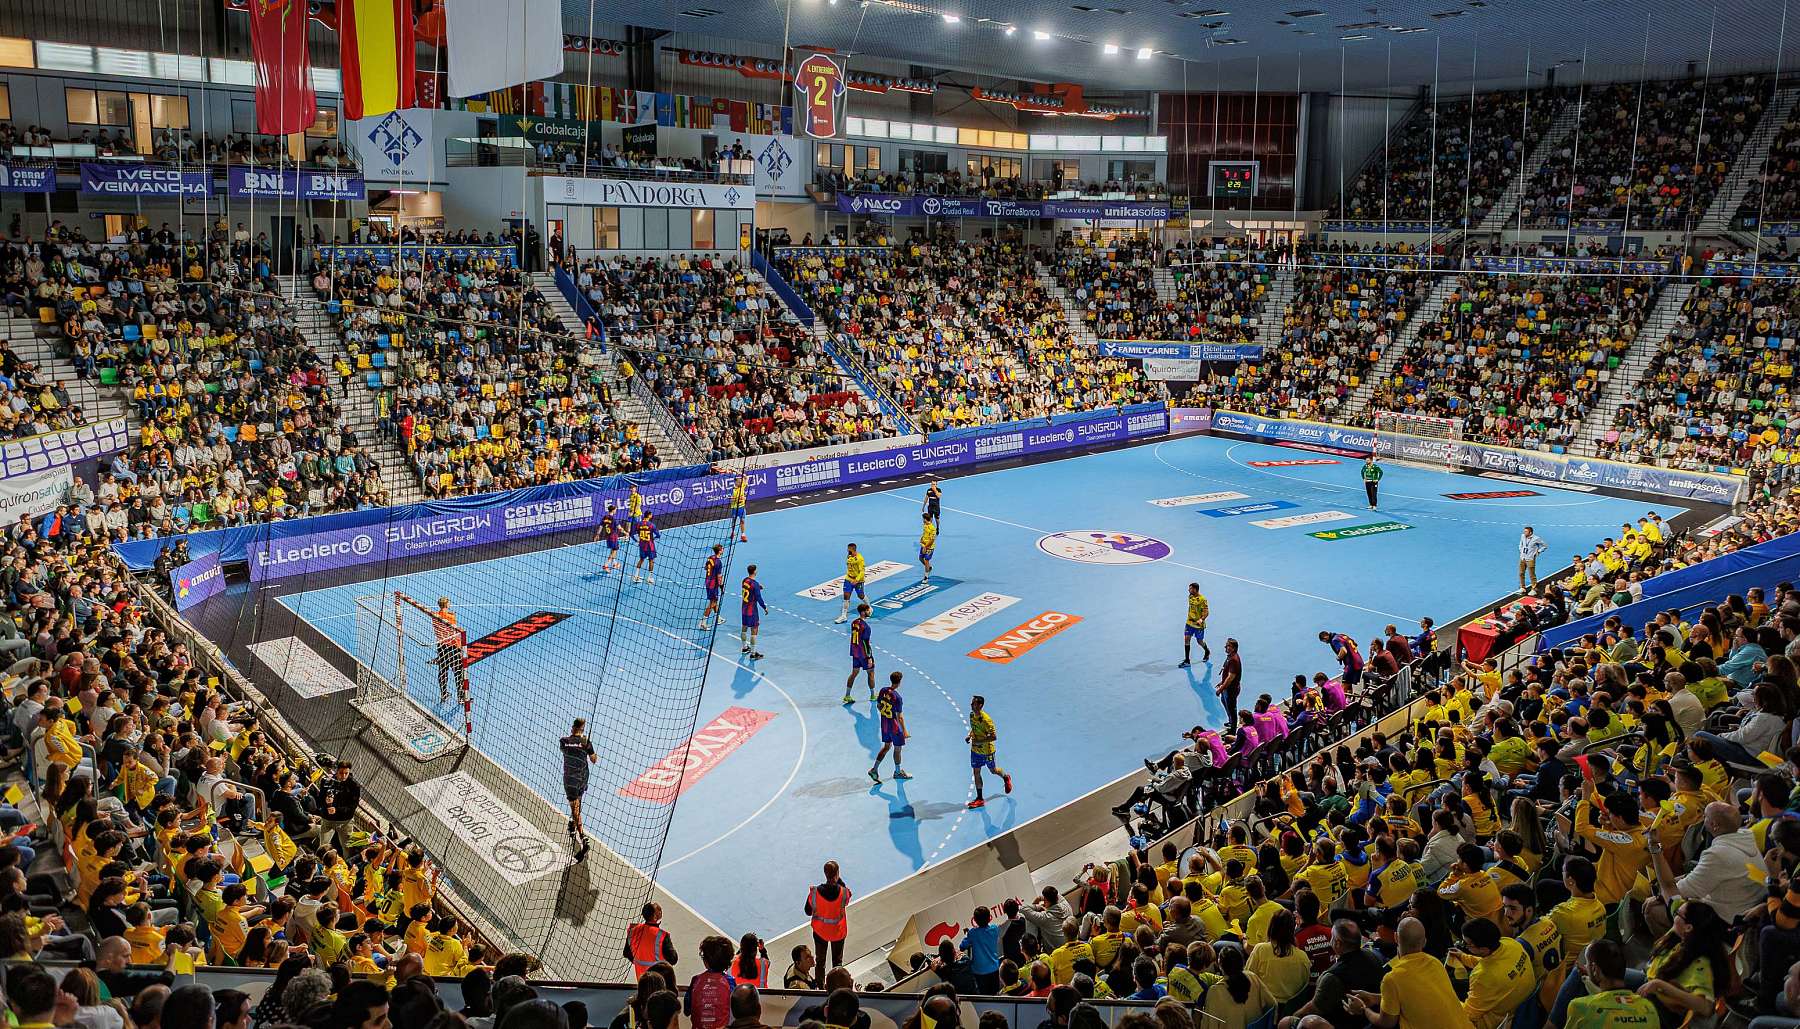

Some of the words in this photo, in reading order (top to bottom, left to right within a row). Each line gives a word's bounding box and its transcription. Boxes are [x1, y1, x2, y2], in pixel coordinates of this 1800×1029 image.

[814, 76, 827, 106] 2
[535, 122, 586, 139] Globalcaja
[12, 171, 46, 179] OBRAS
[117, 169, 181, 180] IVECO
[88, 180, 208, 193] VEIMANCHA
[602, 181, 707, 206] PANDORGA
[864, 198, 902, 210] NACO
[942, 198, 961, 207] Toyota
[1104, 206, 1167, 217] unikasofas
[1118, 346, 1179, 355] FAMILYCARNES
[1183, 414, 1210, 422] amavir
[1078, 420, 1123, 436] SUNGROW
[1298, 428, 1325, 437] BOXLY
[975, 435, 1013, 448] cerysan
[1029, 434, 1065, 446] E.Leclerc
[1342, 434, 1392, 451] Globalaja
[912, 442, 968, 460] SUNGROW
[776, 461, 826, 478] cerysan
[848, 458, 895, 474] E.Leclerc
[1569, 469, 1598, 479] NACO
[692, 473, 767, 495] SUNGOW
[1604, 476, 1661, 489] TALAVERANA
[504, 498, 573, 519] cerysan
[385, 513, 491, 543] SUNGROW
[258, 543, 350, 567] E.Leclerc
[191, 565, 222, 587] amavir
[949, 594, 1001, 619] nexus
[995, 613, 1068, 649] NACO
[638, 717, 745, 787] BOXLY
[448, 805, 493, 843] Toyota
